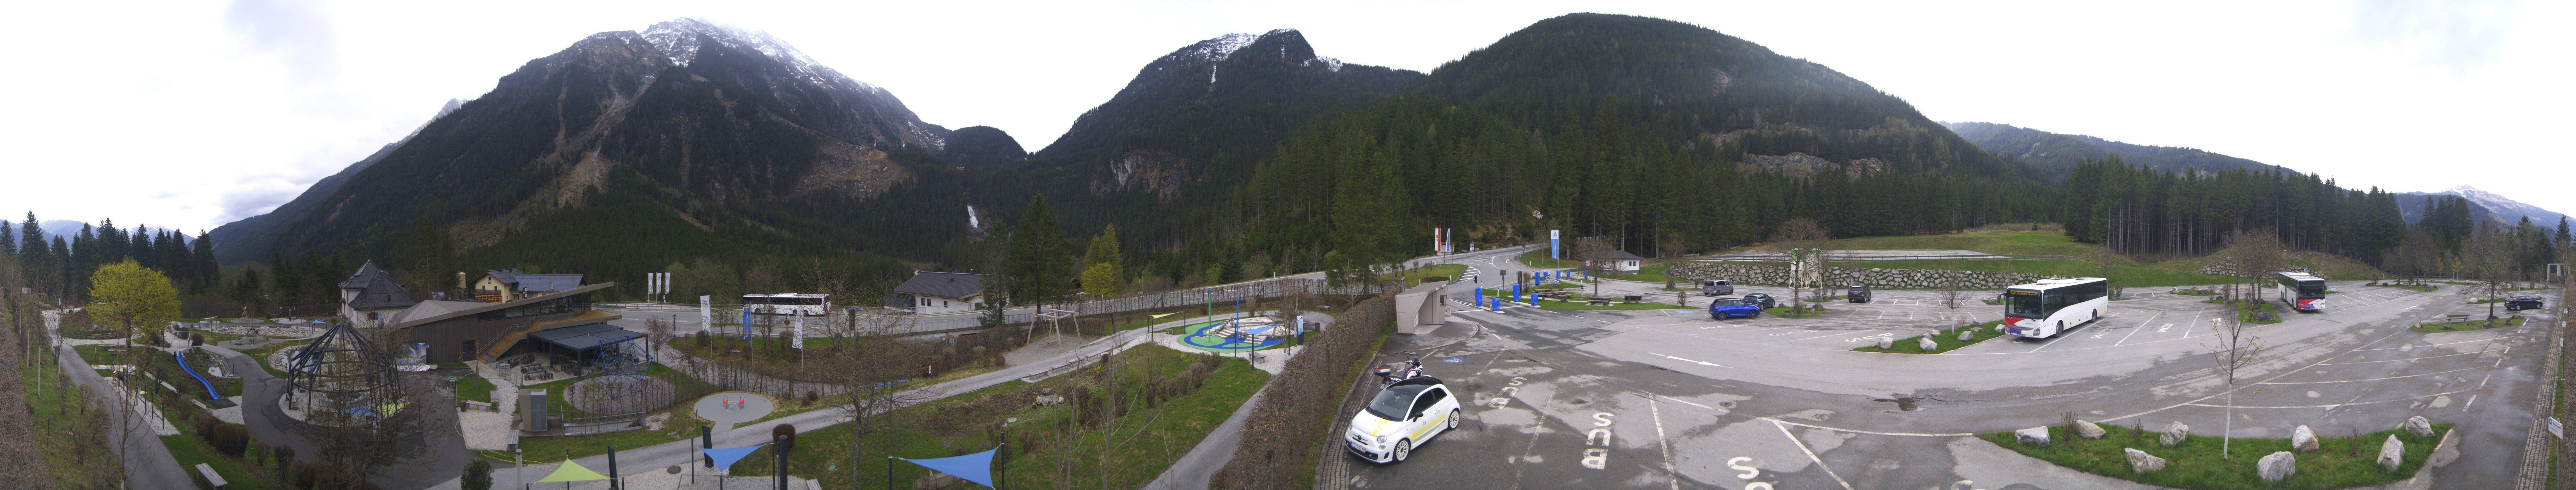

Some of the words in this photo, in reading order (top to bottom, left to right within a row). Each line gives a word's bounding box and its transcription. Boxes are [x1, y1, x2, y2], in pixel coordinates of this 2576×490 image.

[1845, 333, 1894, 342] BUS
[2156, 323, 2174, 332] BUS
[1488, 377, 1527, 409] BUS
[1581, 412, 1614, 469] BUS
